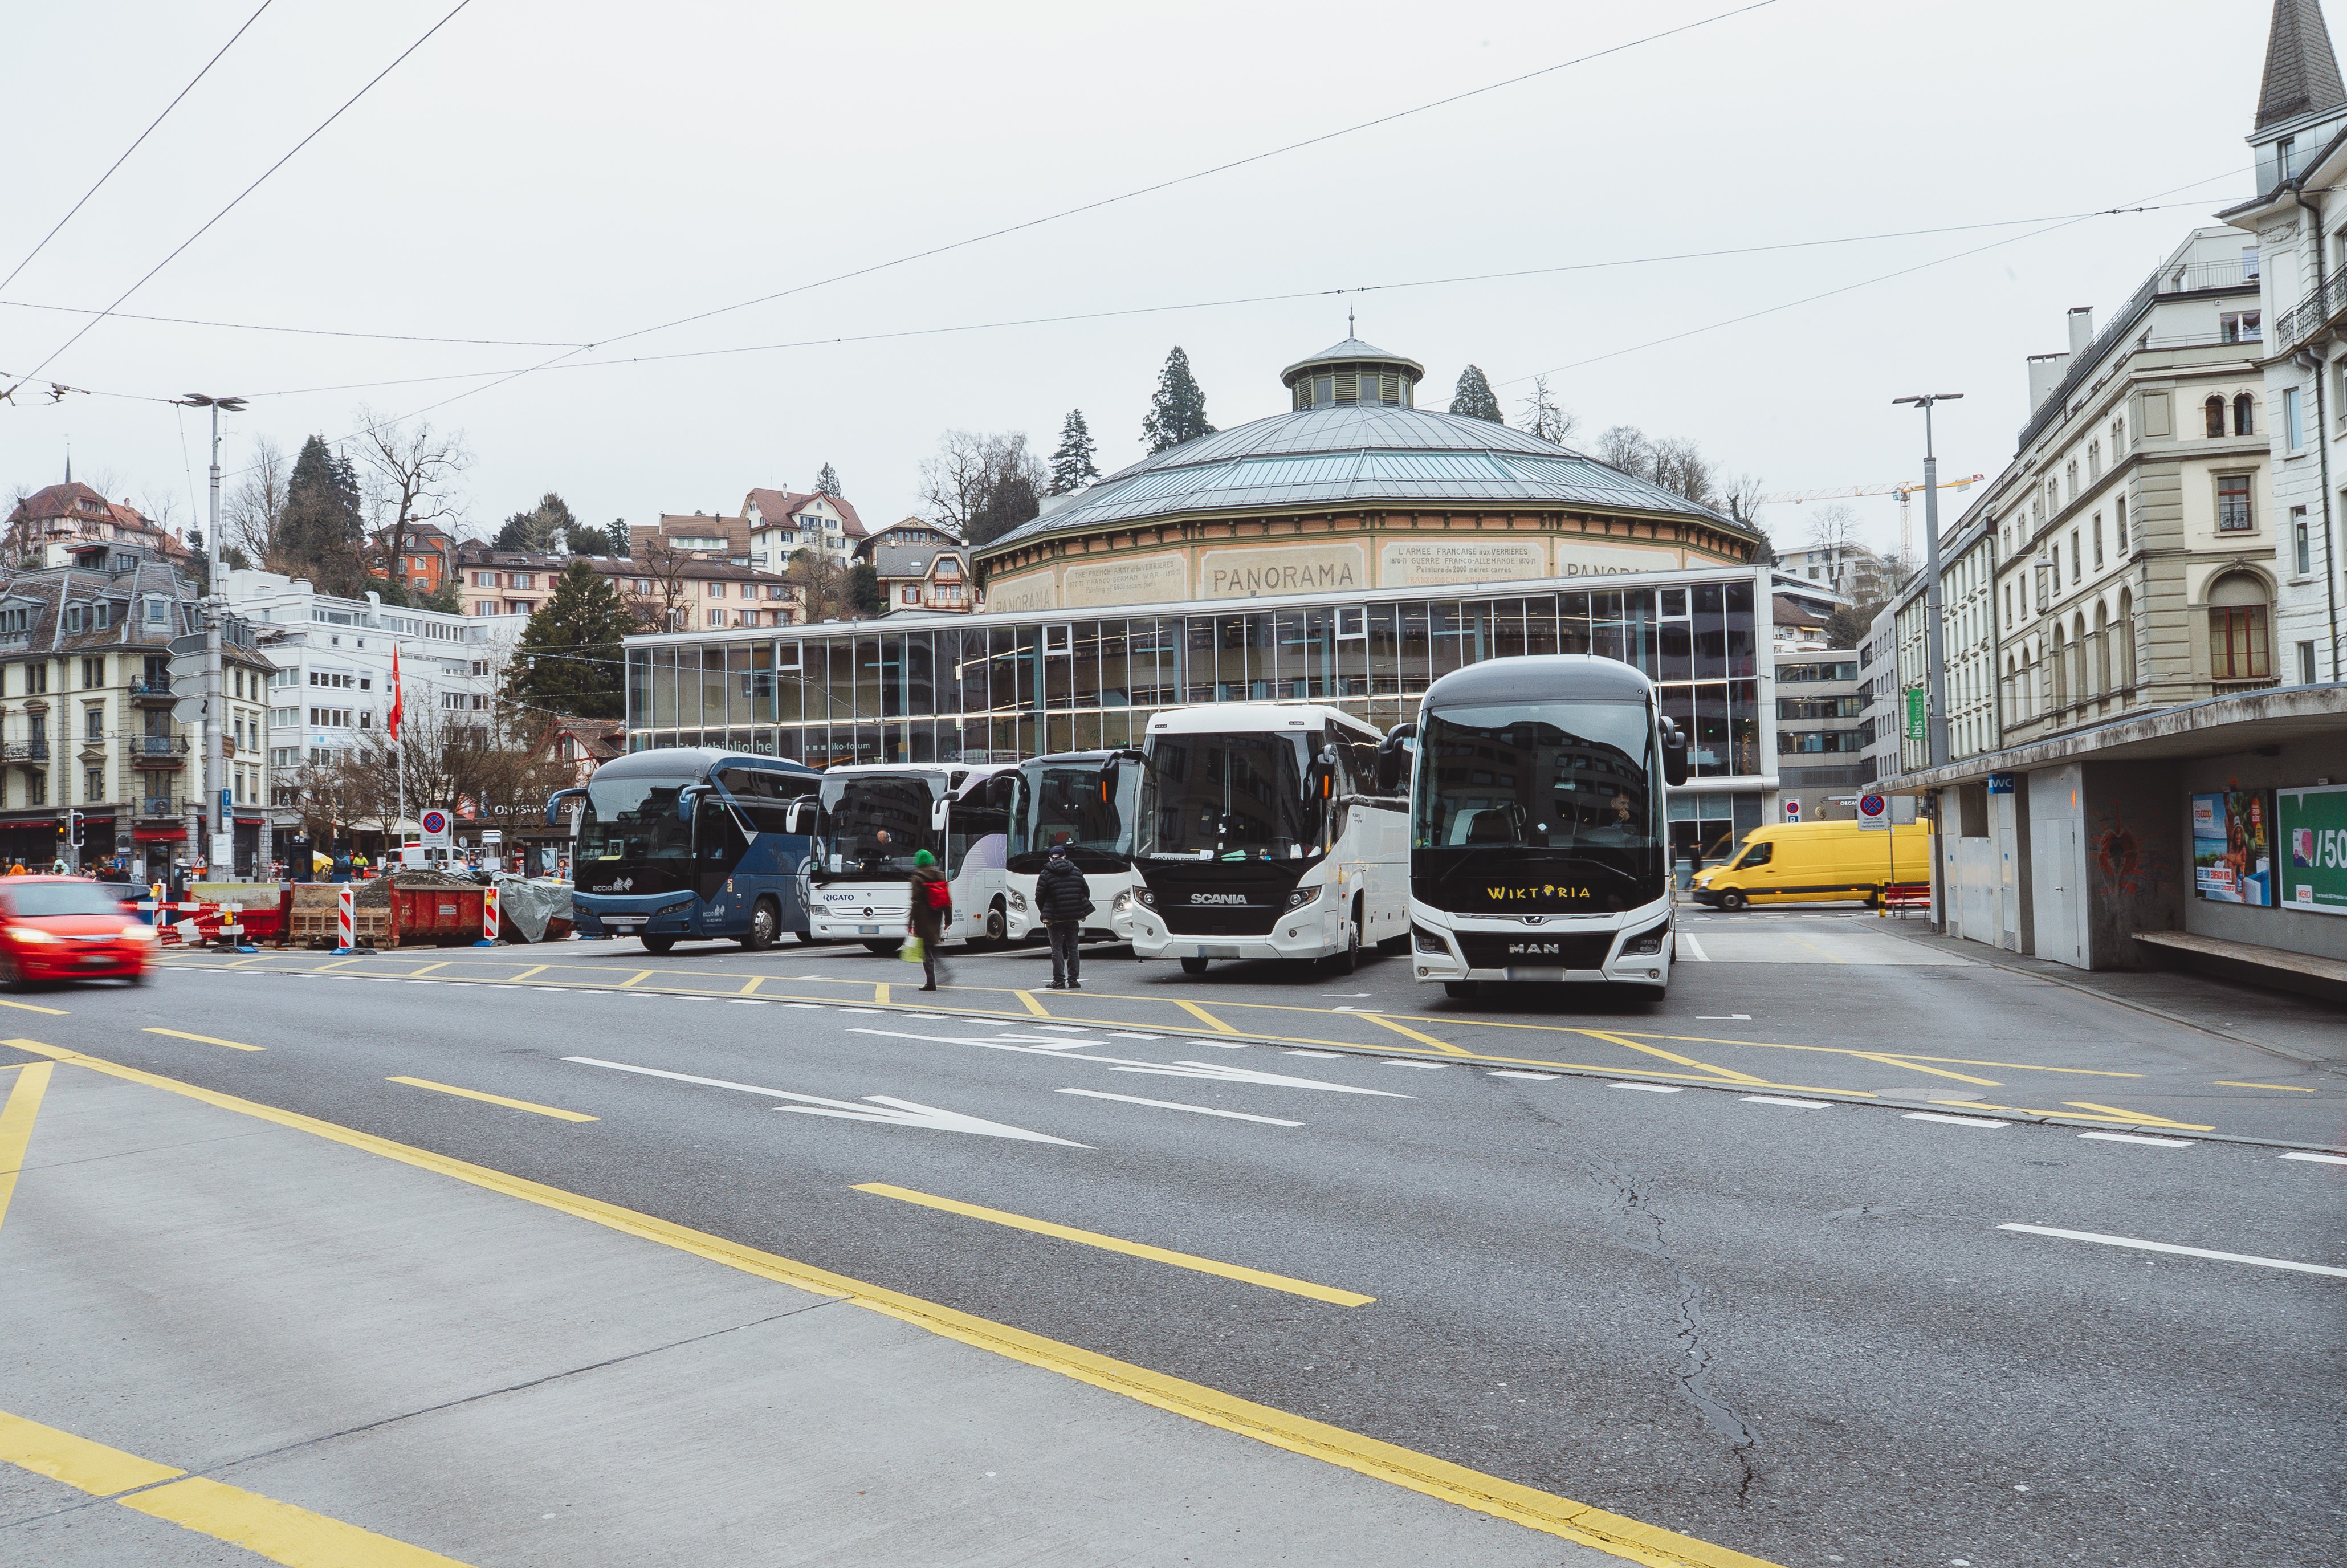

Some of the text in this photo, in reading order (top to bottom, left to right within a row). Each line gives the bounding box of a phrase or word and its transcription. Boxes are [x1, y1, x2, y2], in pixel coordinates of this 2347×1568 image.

[1088, 568, 1111, 577] FRENCH
[1114, 566, 1130, 575] ARMY
[1213, 563, 1354, 592] PANORAMA
[1912, 720, 1923, 738] ibis
[1992, 779, 2012, 787] WC
[1190, 893, 1248, 905] SCANIA
[194, 913, 213, 923] schmid.lu
[1509, 944, 1559, 954] MAN
